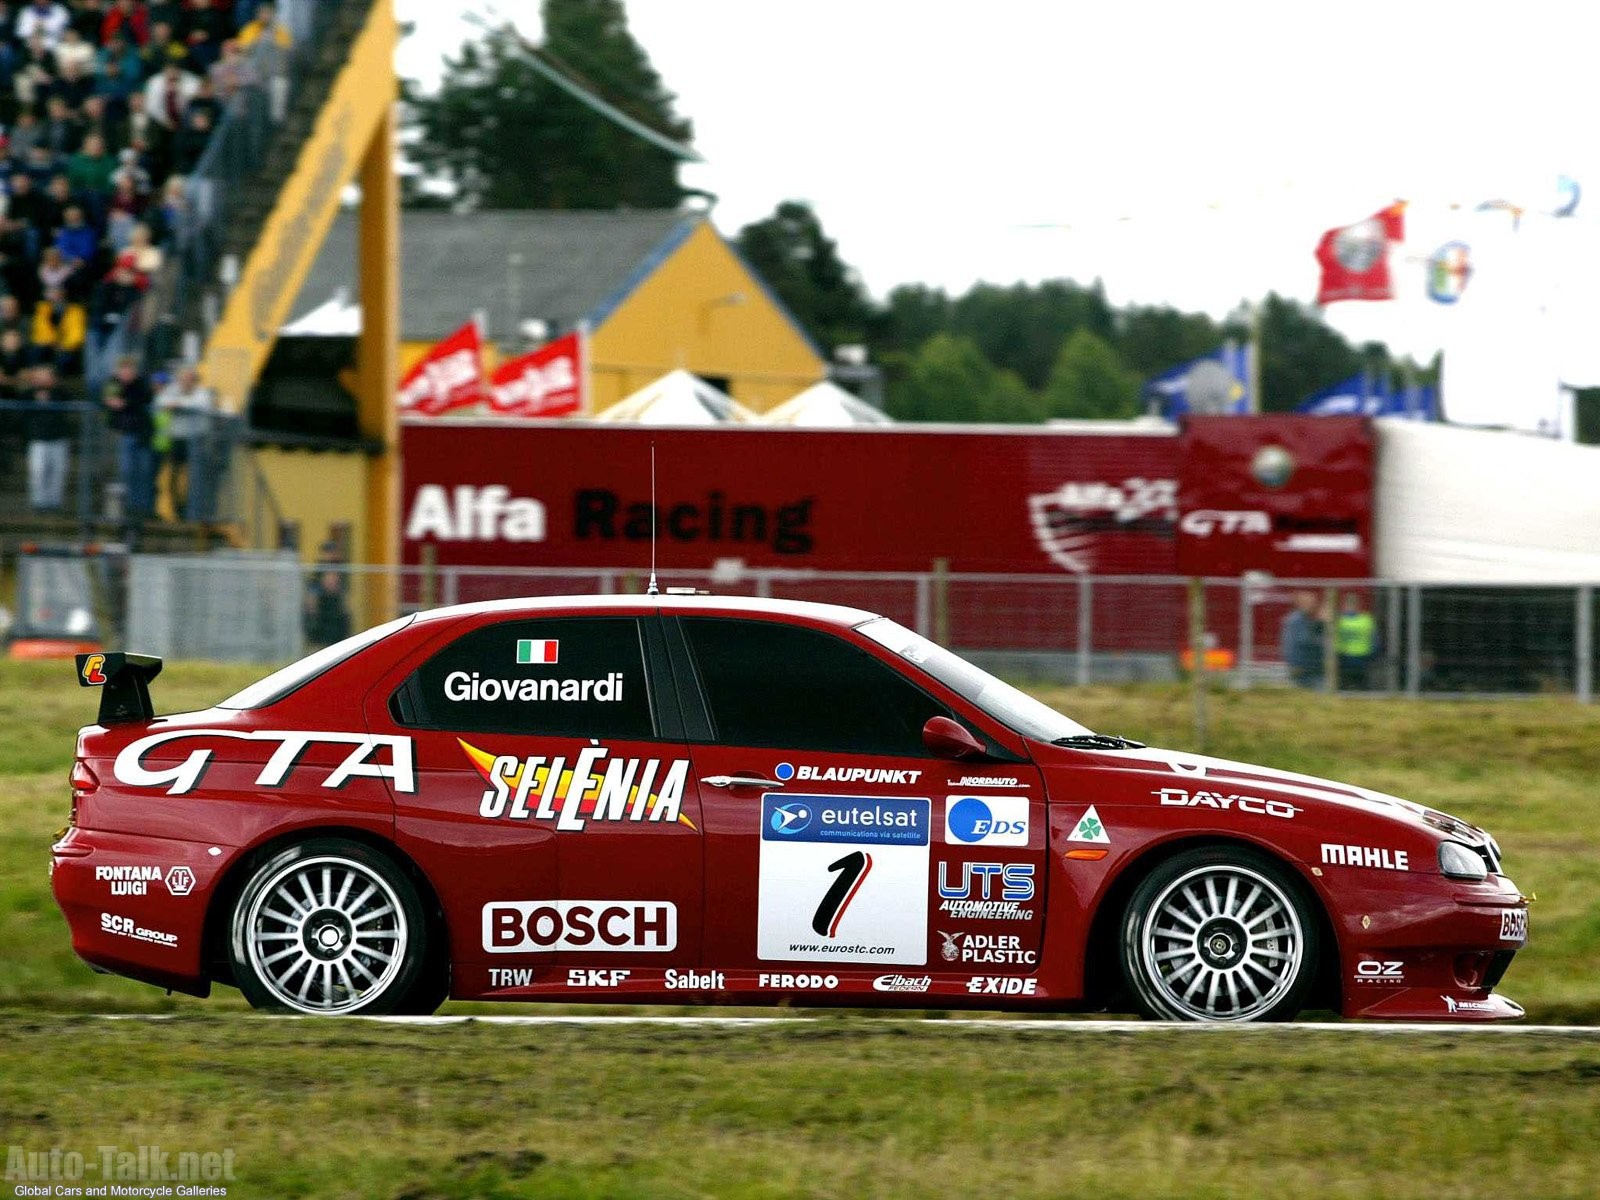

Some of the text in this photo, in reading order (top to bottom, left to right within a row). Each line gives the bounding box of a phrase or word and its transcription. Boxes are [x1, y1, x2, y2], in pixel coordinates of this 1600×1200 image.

[407, 485, 818, 554] Alfa Racing
[1181, 510, 1271, 536] GTA
[444, 671, 624, 704] Giovanardi
[113, 729, 417, 796] GTA
[796, 765, 922, 784] BLAUPUNKT
[479, 738, 690, 831] SELÈNIA
[1151, 788, 1304, 819] DAYCO
[821, 805, 918, 827] eutelsat
[971, 819, 1027, 835] EDS
[1320, 843, 1409, 871] MAHLE
[95, 865, 163, 881] FONTANA
[938, 861, 1035, 901] UTS
[110, 881, 147, 896] LUIGI
[812, 850, 872, 938] 1
[939, 900, 1020, 912] AUTOMOTIVE
[950, 909, 1034, 920] ENGINEERING
[101, 912, 135, 934] SCR
[135, 927, 178, 943] GROUP
[492, 906, 669, 947] BOSCH
[789, 943, 896, 955] www.eurostc.com
[962, 935, 1020, 949] ADLER
[962, 949, 1036, 964] PLASTIC
[488, 968, 533, 986] TRW
[567, 970, 630, 987] SKF
[664, 969, 725, 989] Sabelt
[758, 974, 839, 989] FERODO
[966, 976, 1038, 995] EXIDE
